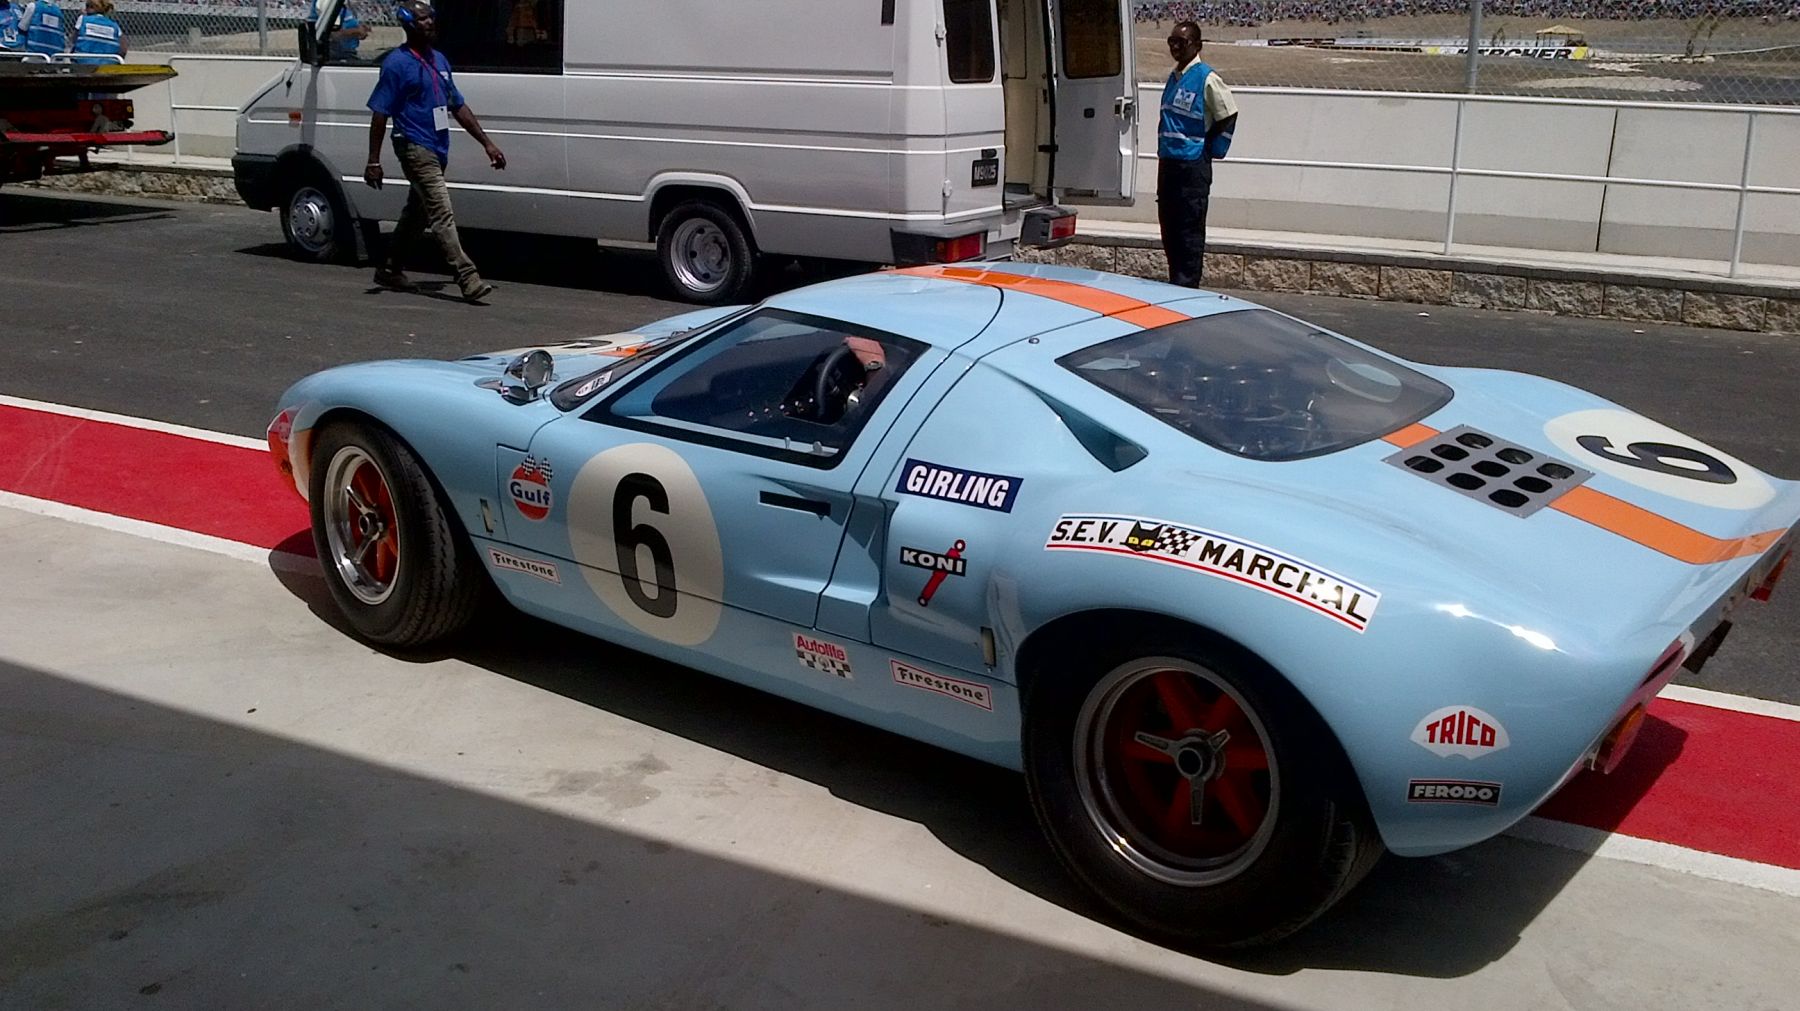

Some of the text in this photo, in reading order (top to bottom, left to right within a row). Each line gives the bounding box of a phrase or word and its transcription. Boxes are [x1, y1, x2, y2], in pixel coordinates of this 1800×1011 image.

[1576, 435, 1737, 484] 6
[510, 481, 551, 506] Gulf
[906, 465, 1010, 508] GIRLING
[613, 472, 678, 619] 6
[903, 549, 963, 573] KONI
[493, 551, 555, 577] Firestone
[1051, 520, 1367, 623] S.E.V. MARCHAL
[797, 635, 846, 662] Autolite
[897, 667, 984, 701] Firestone
[1426, 710, 1496, 747] TRICO
[1413, 785, 1494, 800] FERODO
